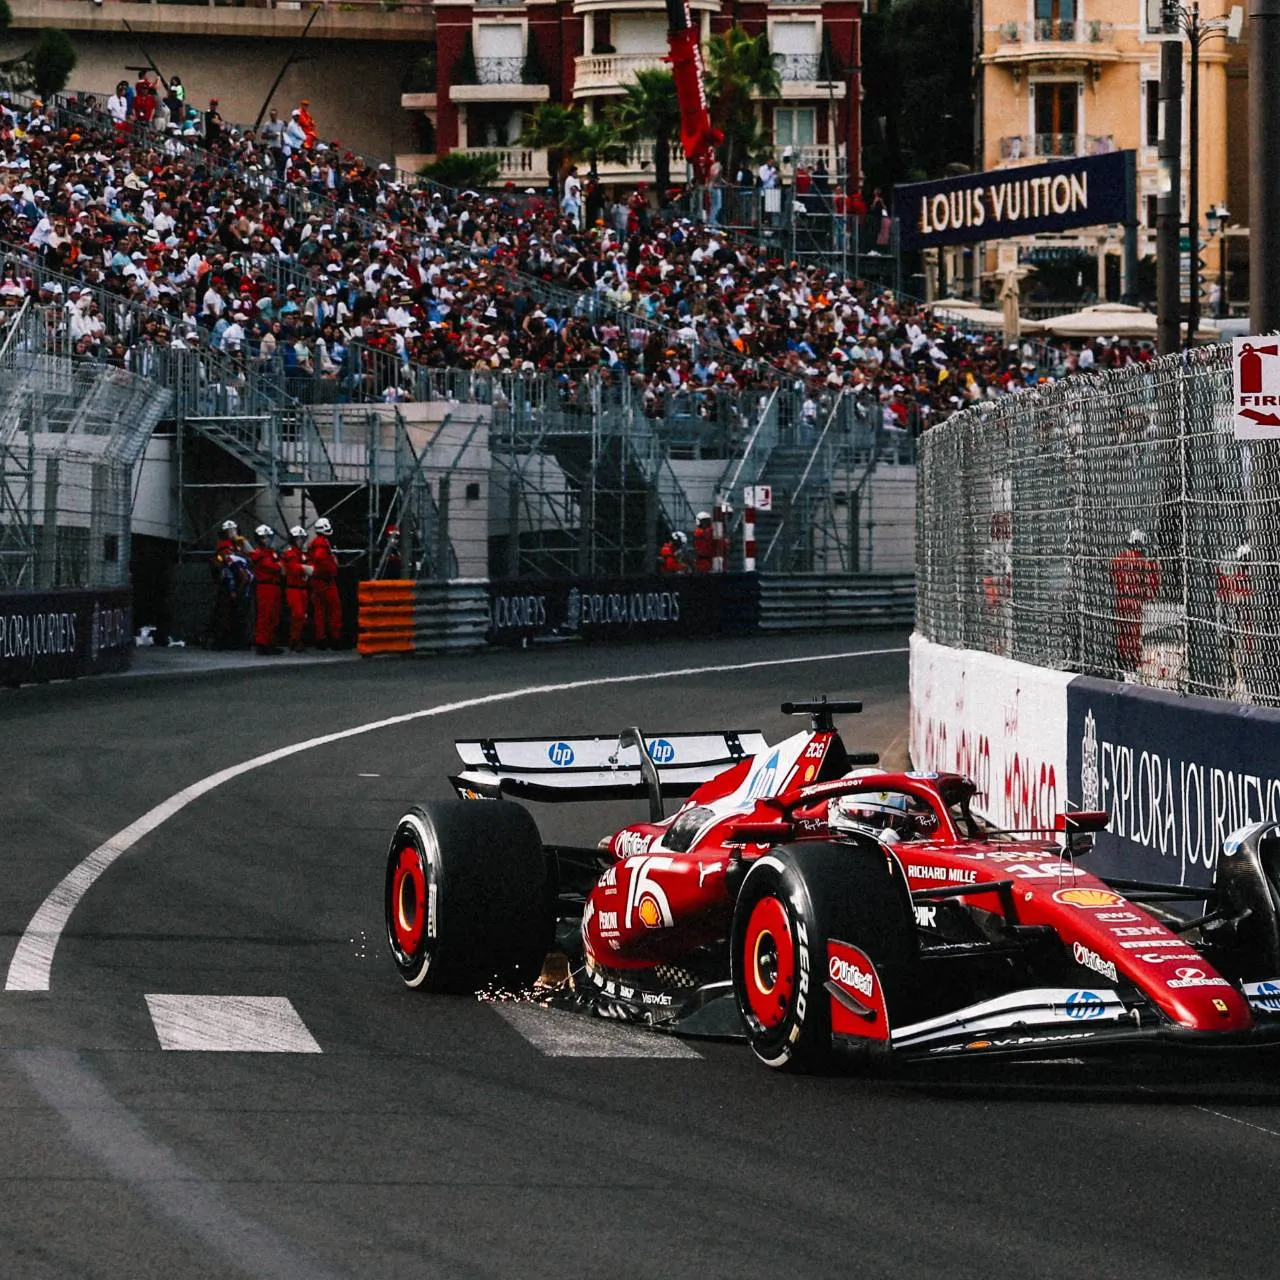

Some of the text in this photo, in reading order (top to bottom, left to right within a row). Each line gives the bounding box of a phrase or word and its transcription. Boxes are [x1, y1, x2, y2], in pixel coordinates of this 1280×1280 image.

[921, 171, 1088, 233] LOUIS VUITTON
[551, 743, 573, 766] hp
[651, 739, 673, 762] hp
[1101, 741, 1177, 856] EXPLORA
[908, 865, 977, 883] RICHARD MILLE
[1004, 863, 1087, 878] 16
[1109, 927, 1167, 937] IBM
[796, 920, 810, 1023] ZERO
